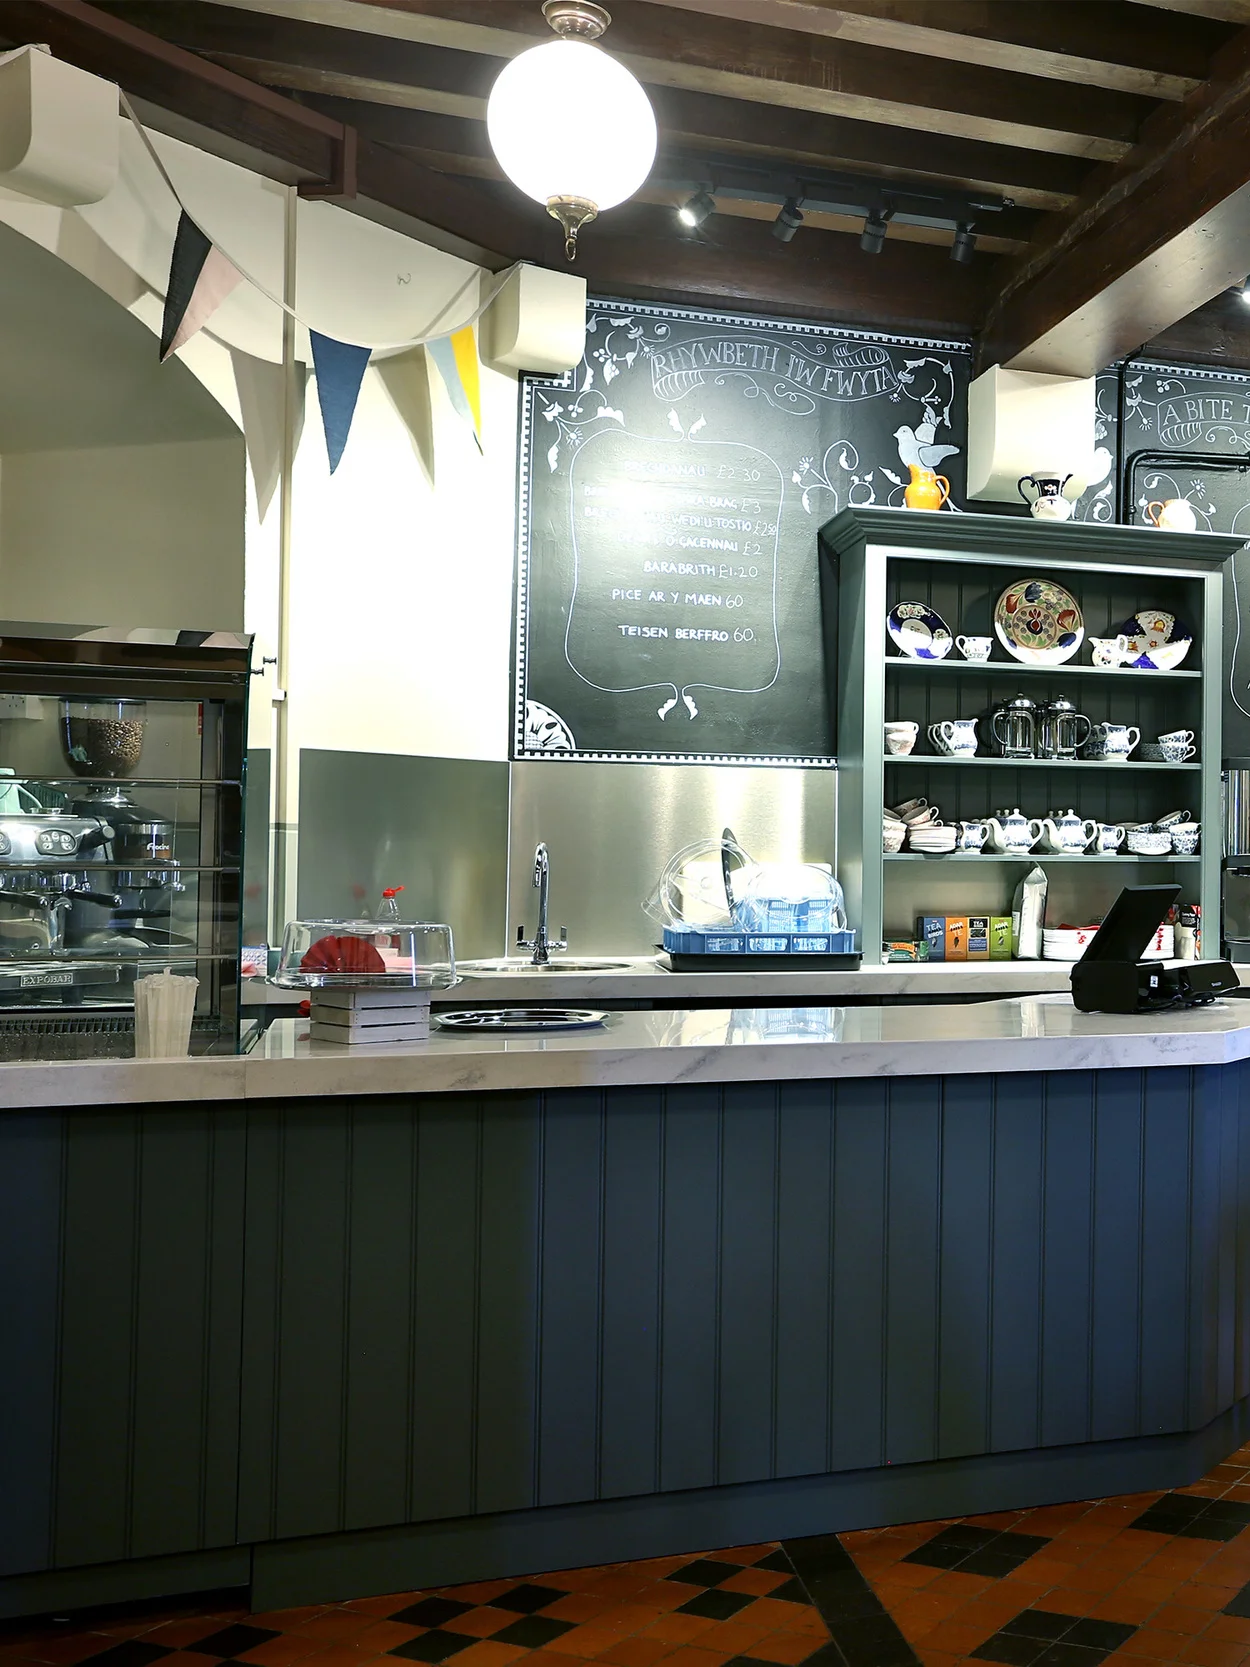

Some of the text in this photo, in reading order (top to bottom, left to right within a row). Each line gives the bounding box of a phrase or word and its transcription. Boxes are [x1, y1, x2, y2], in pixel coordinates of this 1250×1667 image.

[654, 341, 780, 379] RHYWBETH
[821, 366, 900, 397] FWYTA
[1162, 404, 1182, 426] A
[1184, 398, 1234, 422] BITE
[742, 541, 763, 556] £2
[643, 560, 716, 577] BARABRITH
[611, 588, 744, 609] PICE AR Y MAEN 60
[617, 624, 669, 639] TEISEN
[674, 627, 729, 642] BERFFRO
[22, 974, 72, 985] EXPOBAR
